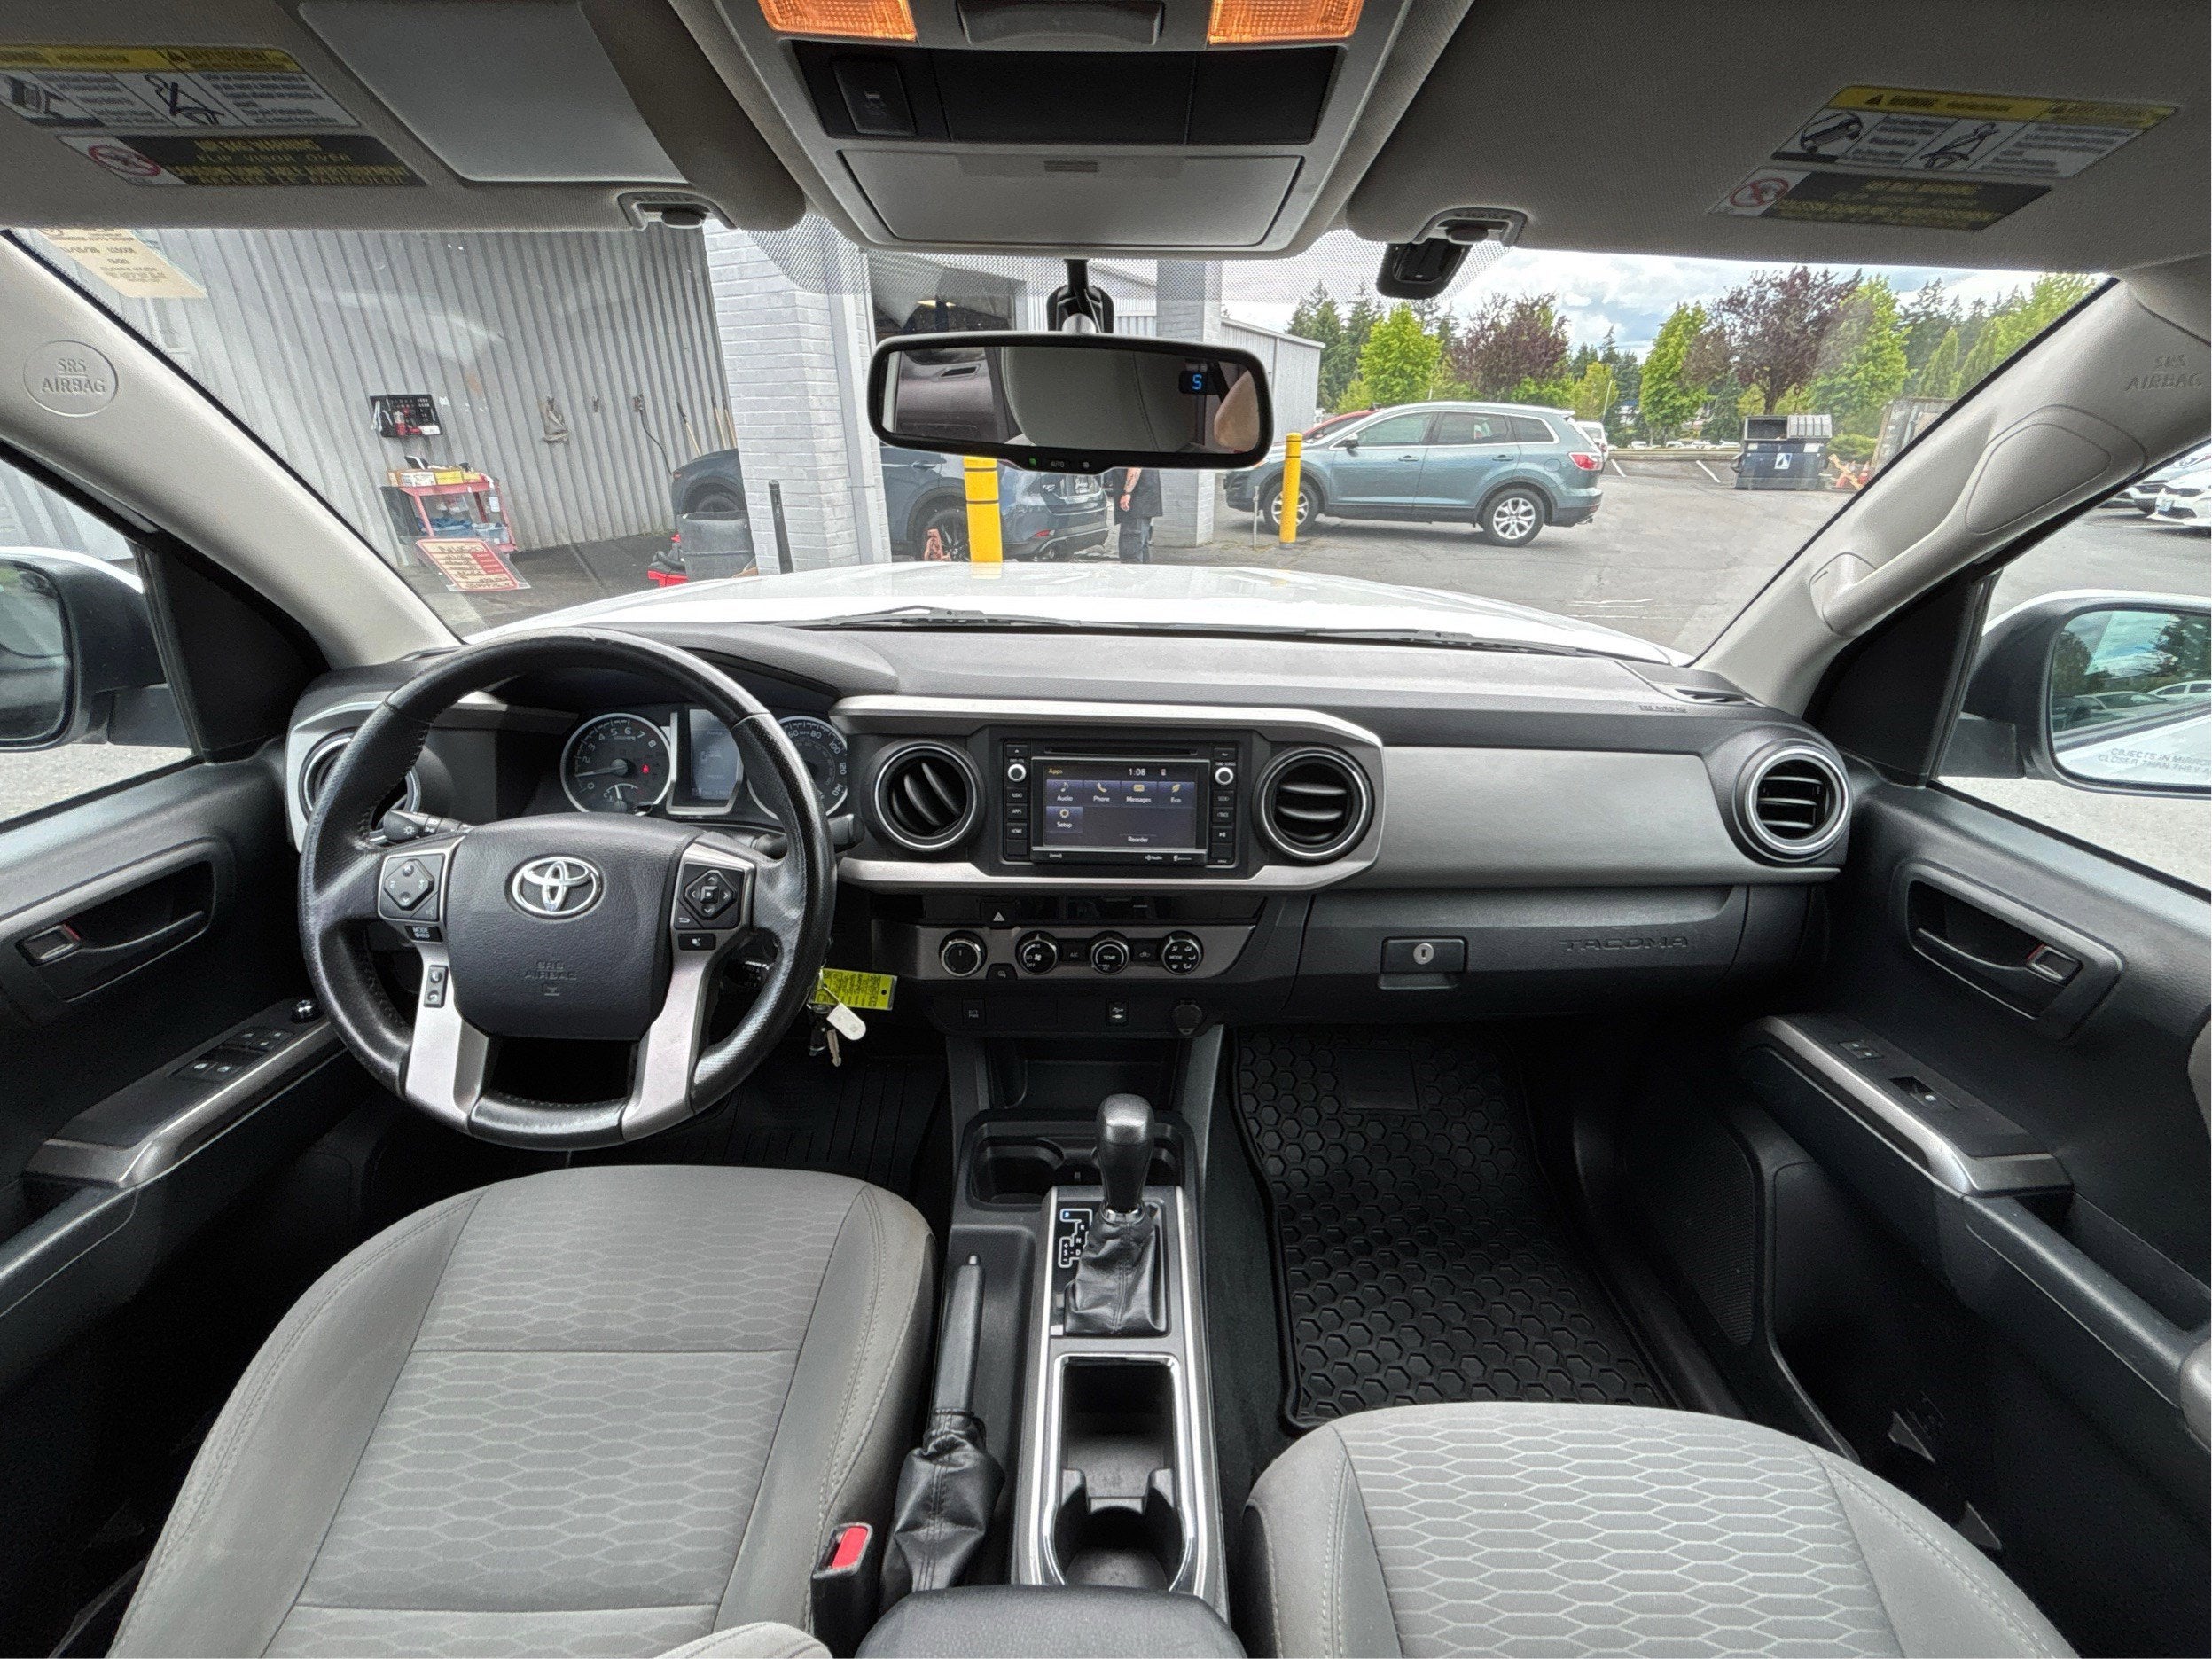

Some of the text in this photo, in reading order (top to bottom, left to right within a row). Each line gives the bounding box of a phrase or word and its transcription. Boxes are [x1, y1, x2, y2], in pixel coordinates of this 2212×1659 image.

[58, 358, 87, 373] SRS
[42, 377, 106, 393] AIRBAG
[624, 726, 632, 735] 6
[810, 730, 822, 740] 80
[648, 740, 657, 748] 8
[829, 741, 841, 754] 100
[2098, 754, 2139, 766] CLOSER
[839, 762, 848, 775] 120
[832, 783, 844, 796] 140
[1559, 936, 1688, 951] TACOMA
